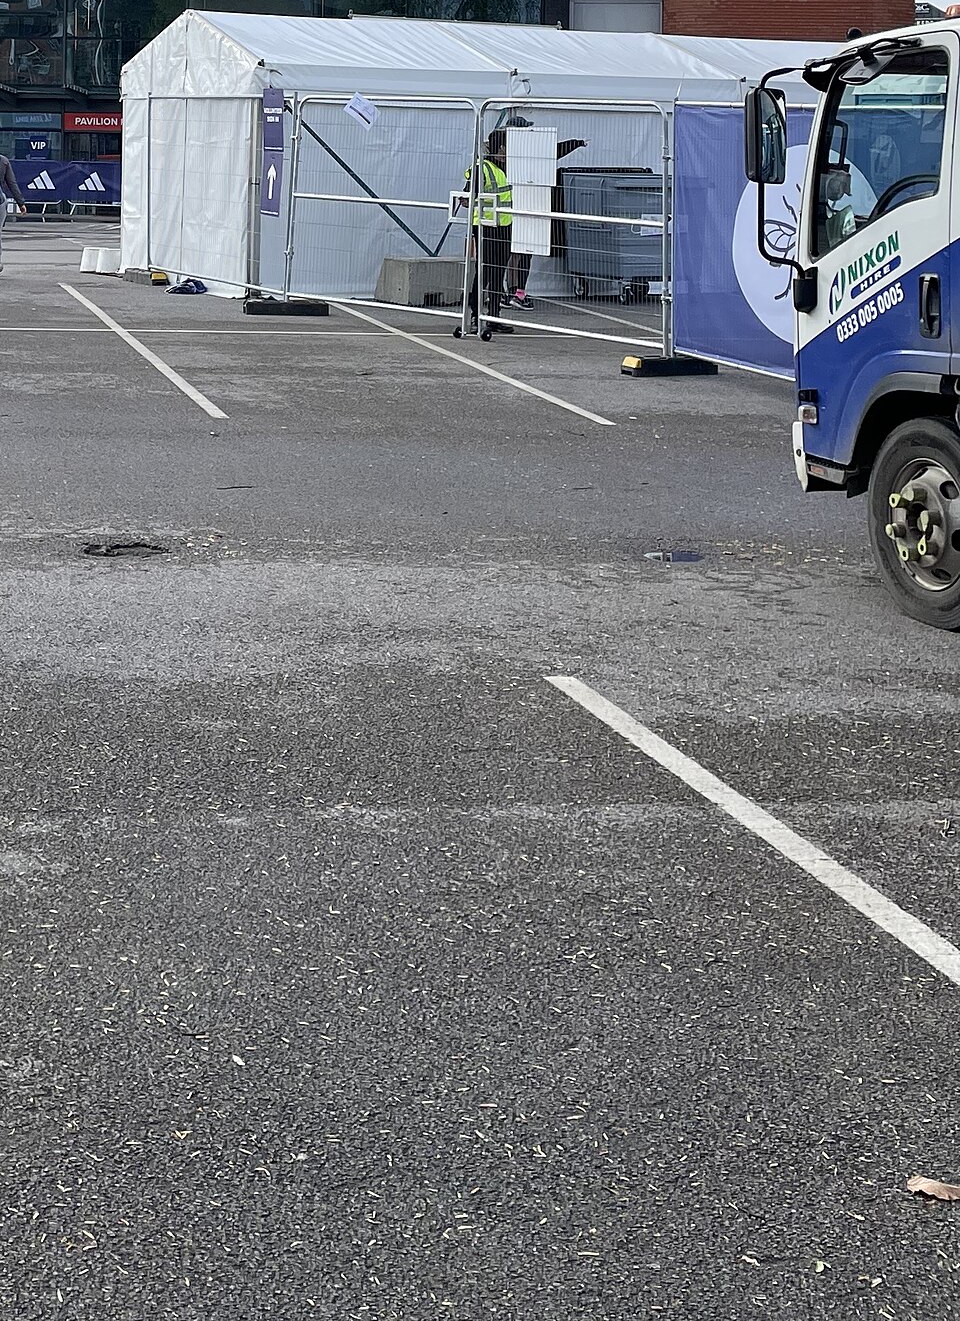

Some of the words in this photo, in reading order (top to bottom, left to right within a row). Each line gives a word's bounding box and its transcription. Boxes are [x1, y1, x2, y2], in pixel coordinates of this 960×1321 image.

[74, 117, 118, 126] PAVILION
[30, 141, 46, 150] VIP
[847, 230, 900, 285] NIXON
[860, 264, 891, 291] HIRE
[836, 313, 859, 343] 0333
[858, 301, 878, 327] 005
[876, 282, 905, 316] 0005
